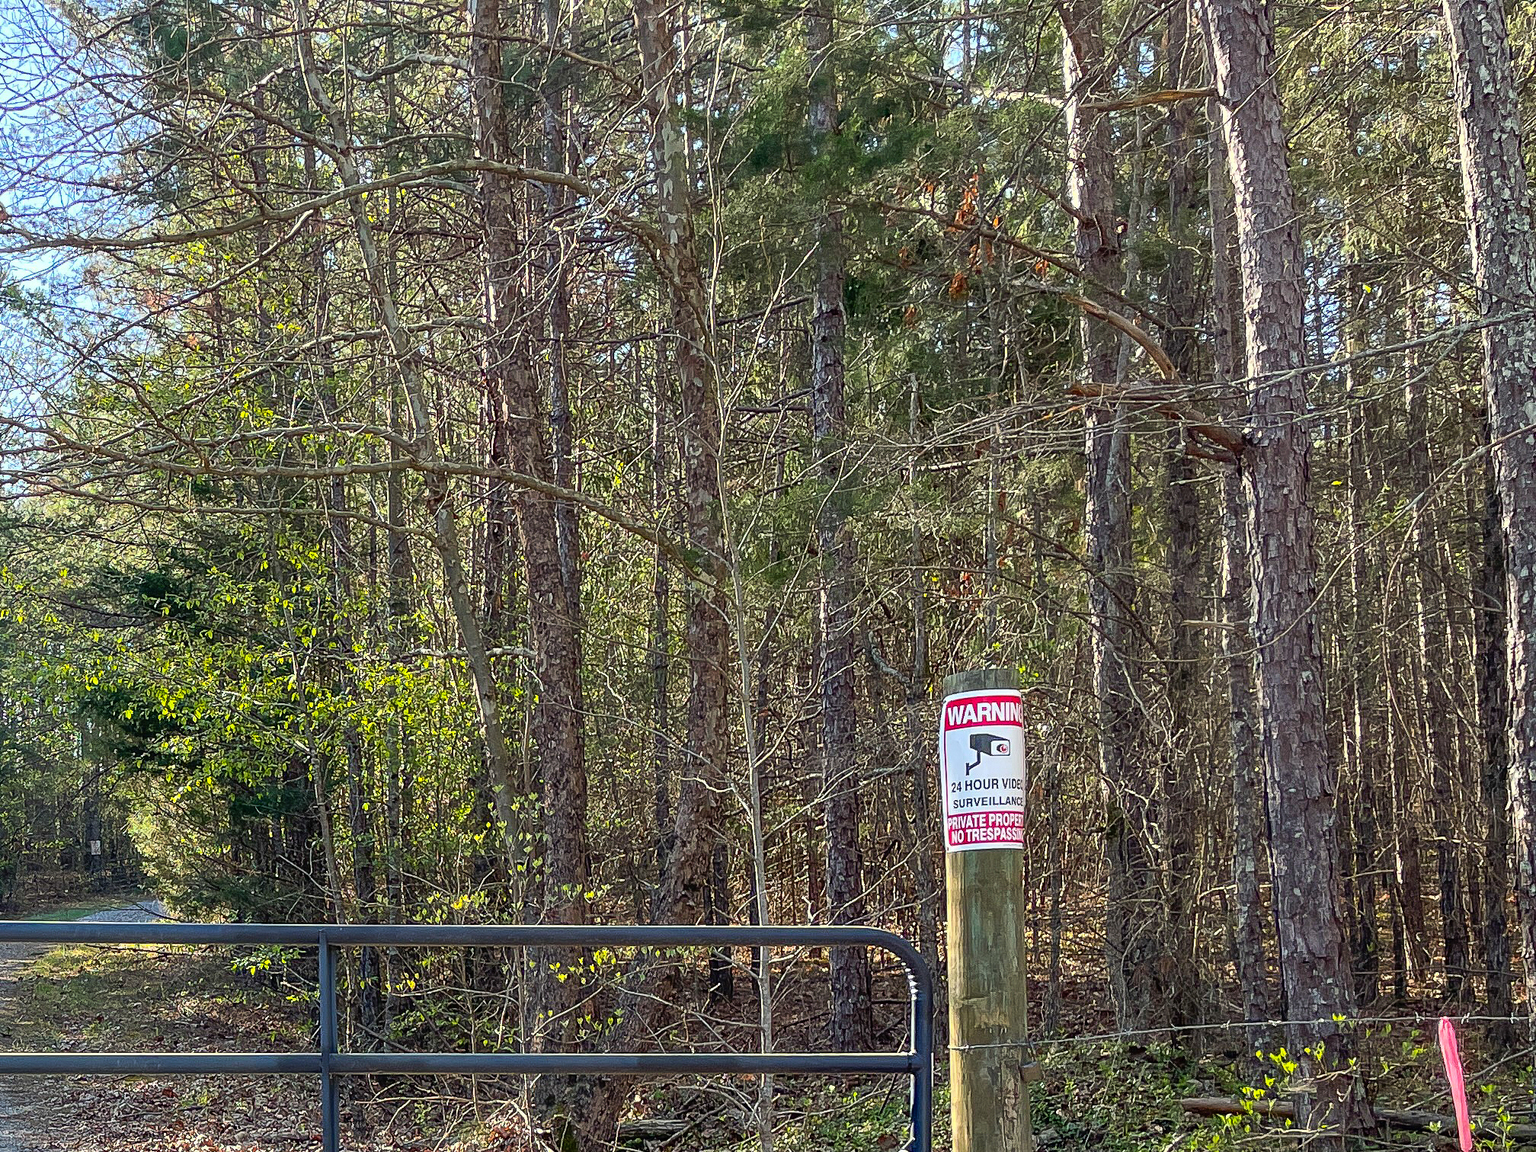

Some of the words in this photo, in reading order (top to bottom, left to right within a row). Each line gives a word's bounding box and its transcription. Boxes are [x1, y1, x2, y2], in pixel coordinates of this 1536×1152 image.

[951, 780, 962, 793] 24
[965, 778, 999, 791] HOUR
[948, 814, 986, 830] PRIVATE
[951, 828, 964, 843] NO
